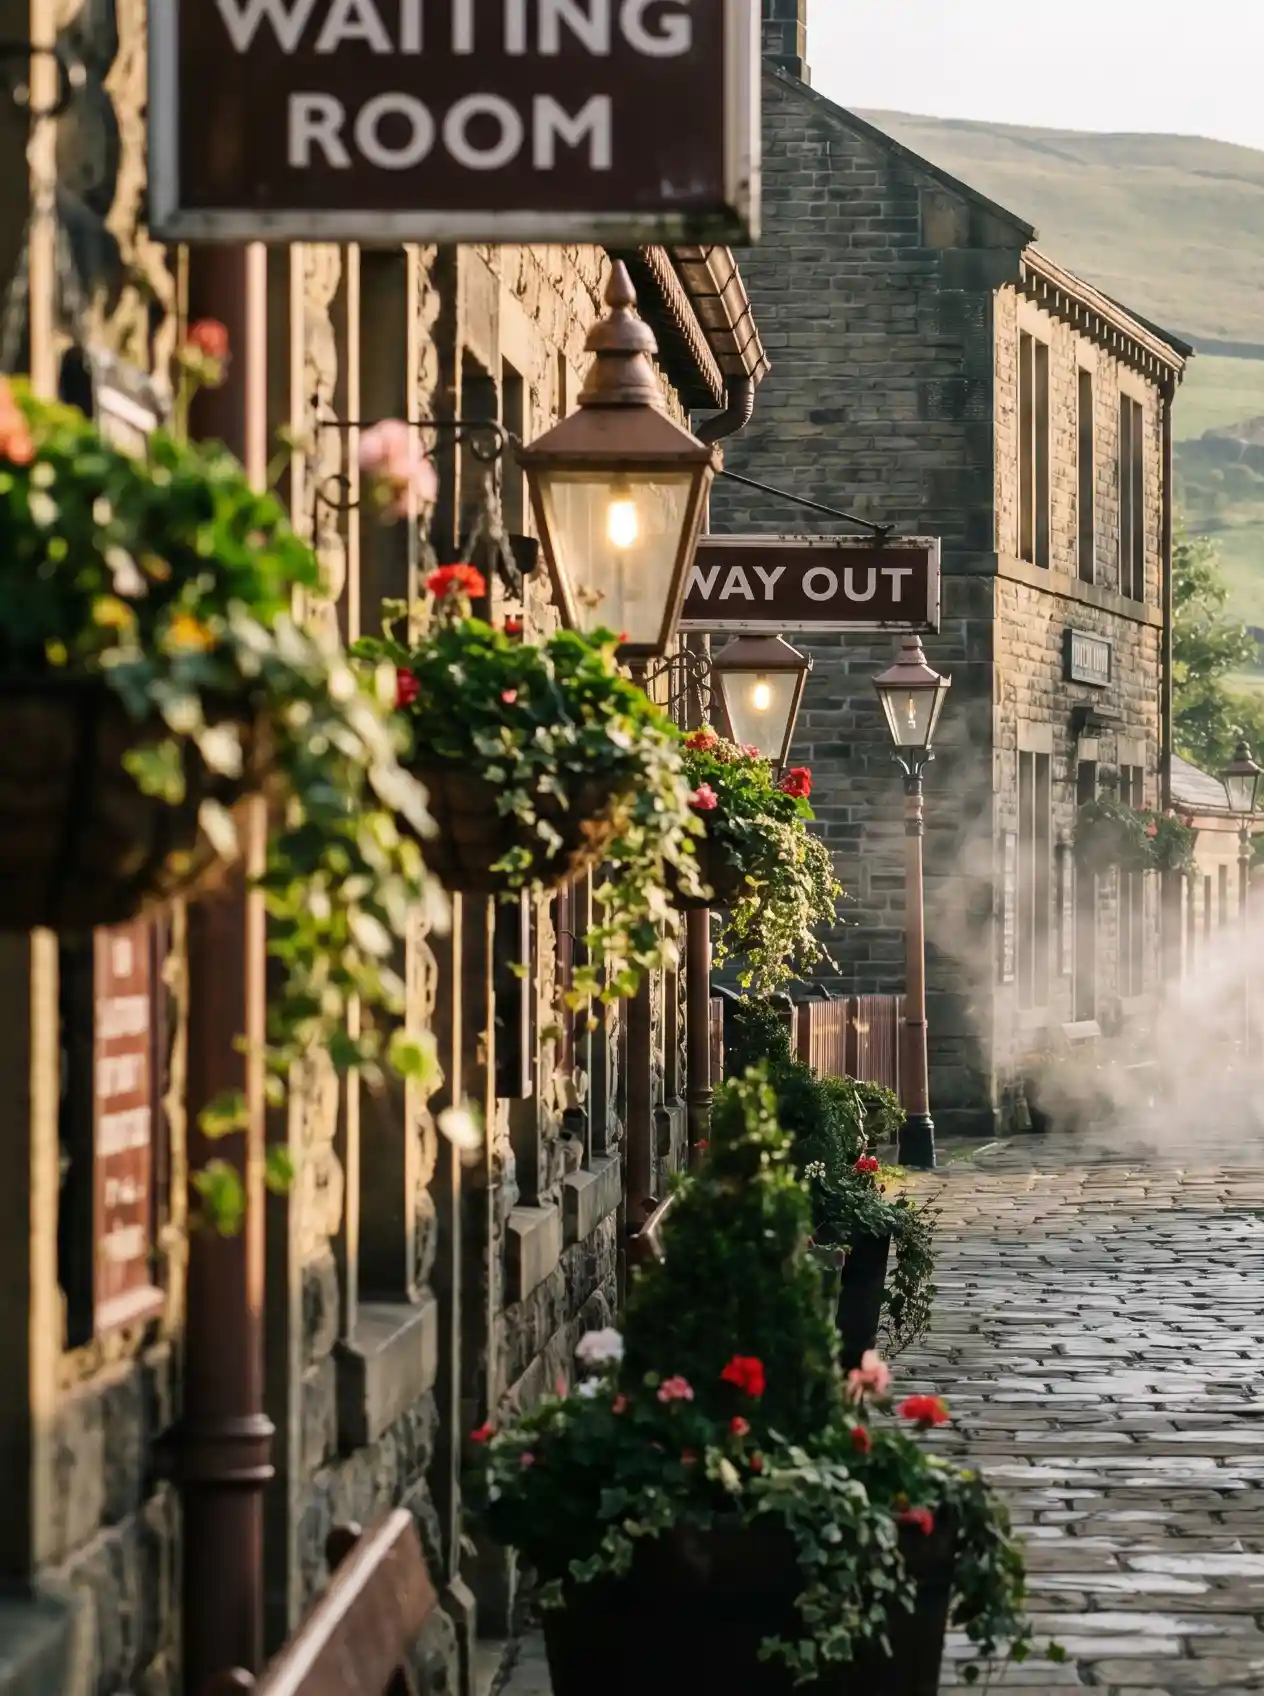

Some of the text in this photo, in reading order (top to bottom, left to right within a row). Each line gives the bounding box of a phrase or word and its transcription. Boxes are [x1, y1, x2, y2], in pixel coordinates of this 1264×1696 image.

[217, 0, 692, 56] WAITING
[288, 93, 611, 170] ROOM
[801, 566, 912, 602] OUT
